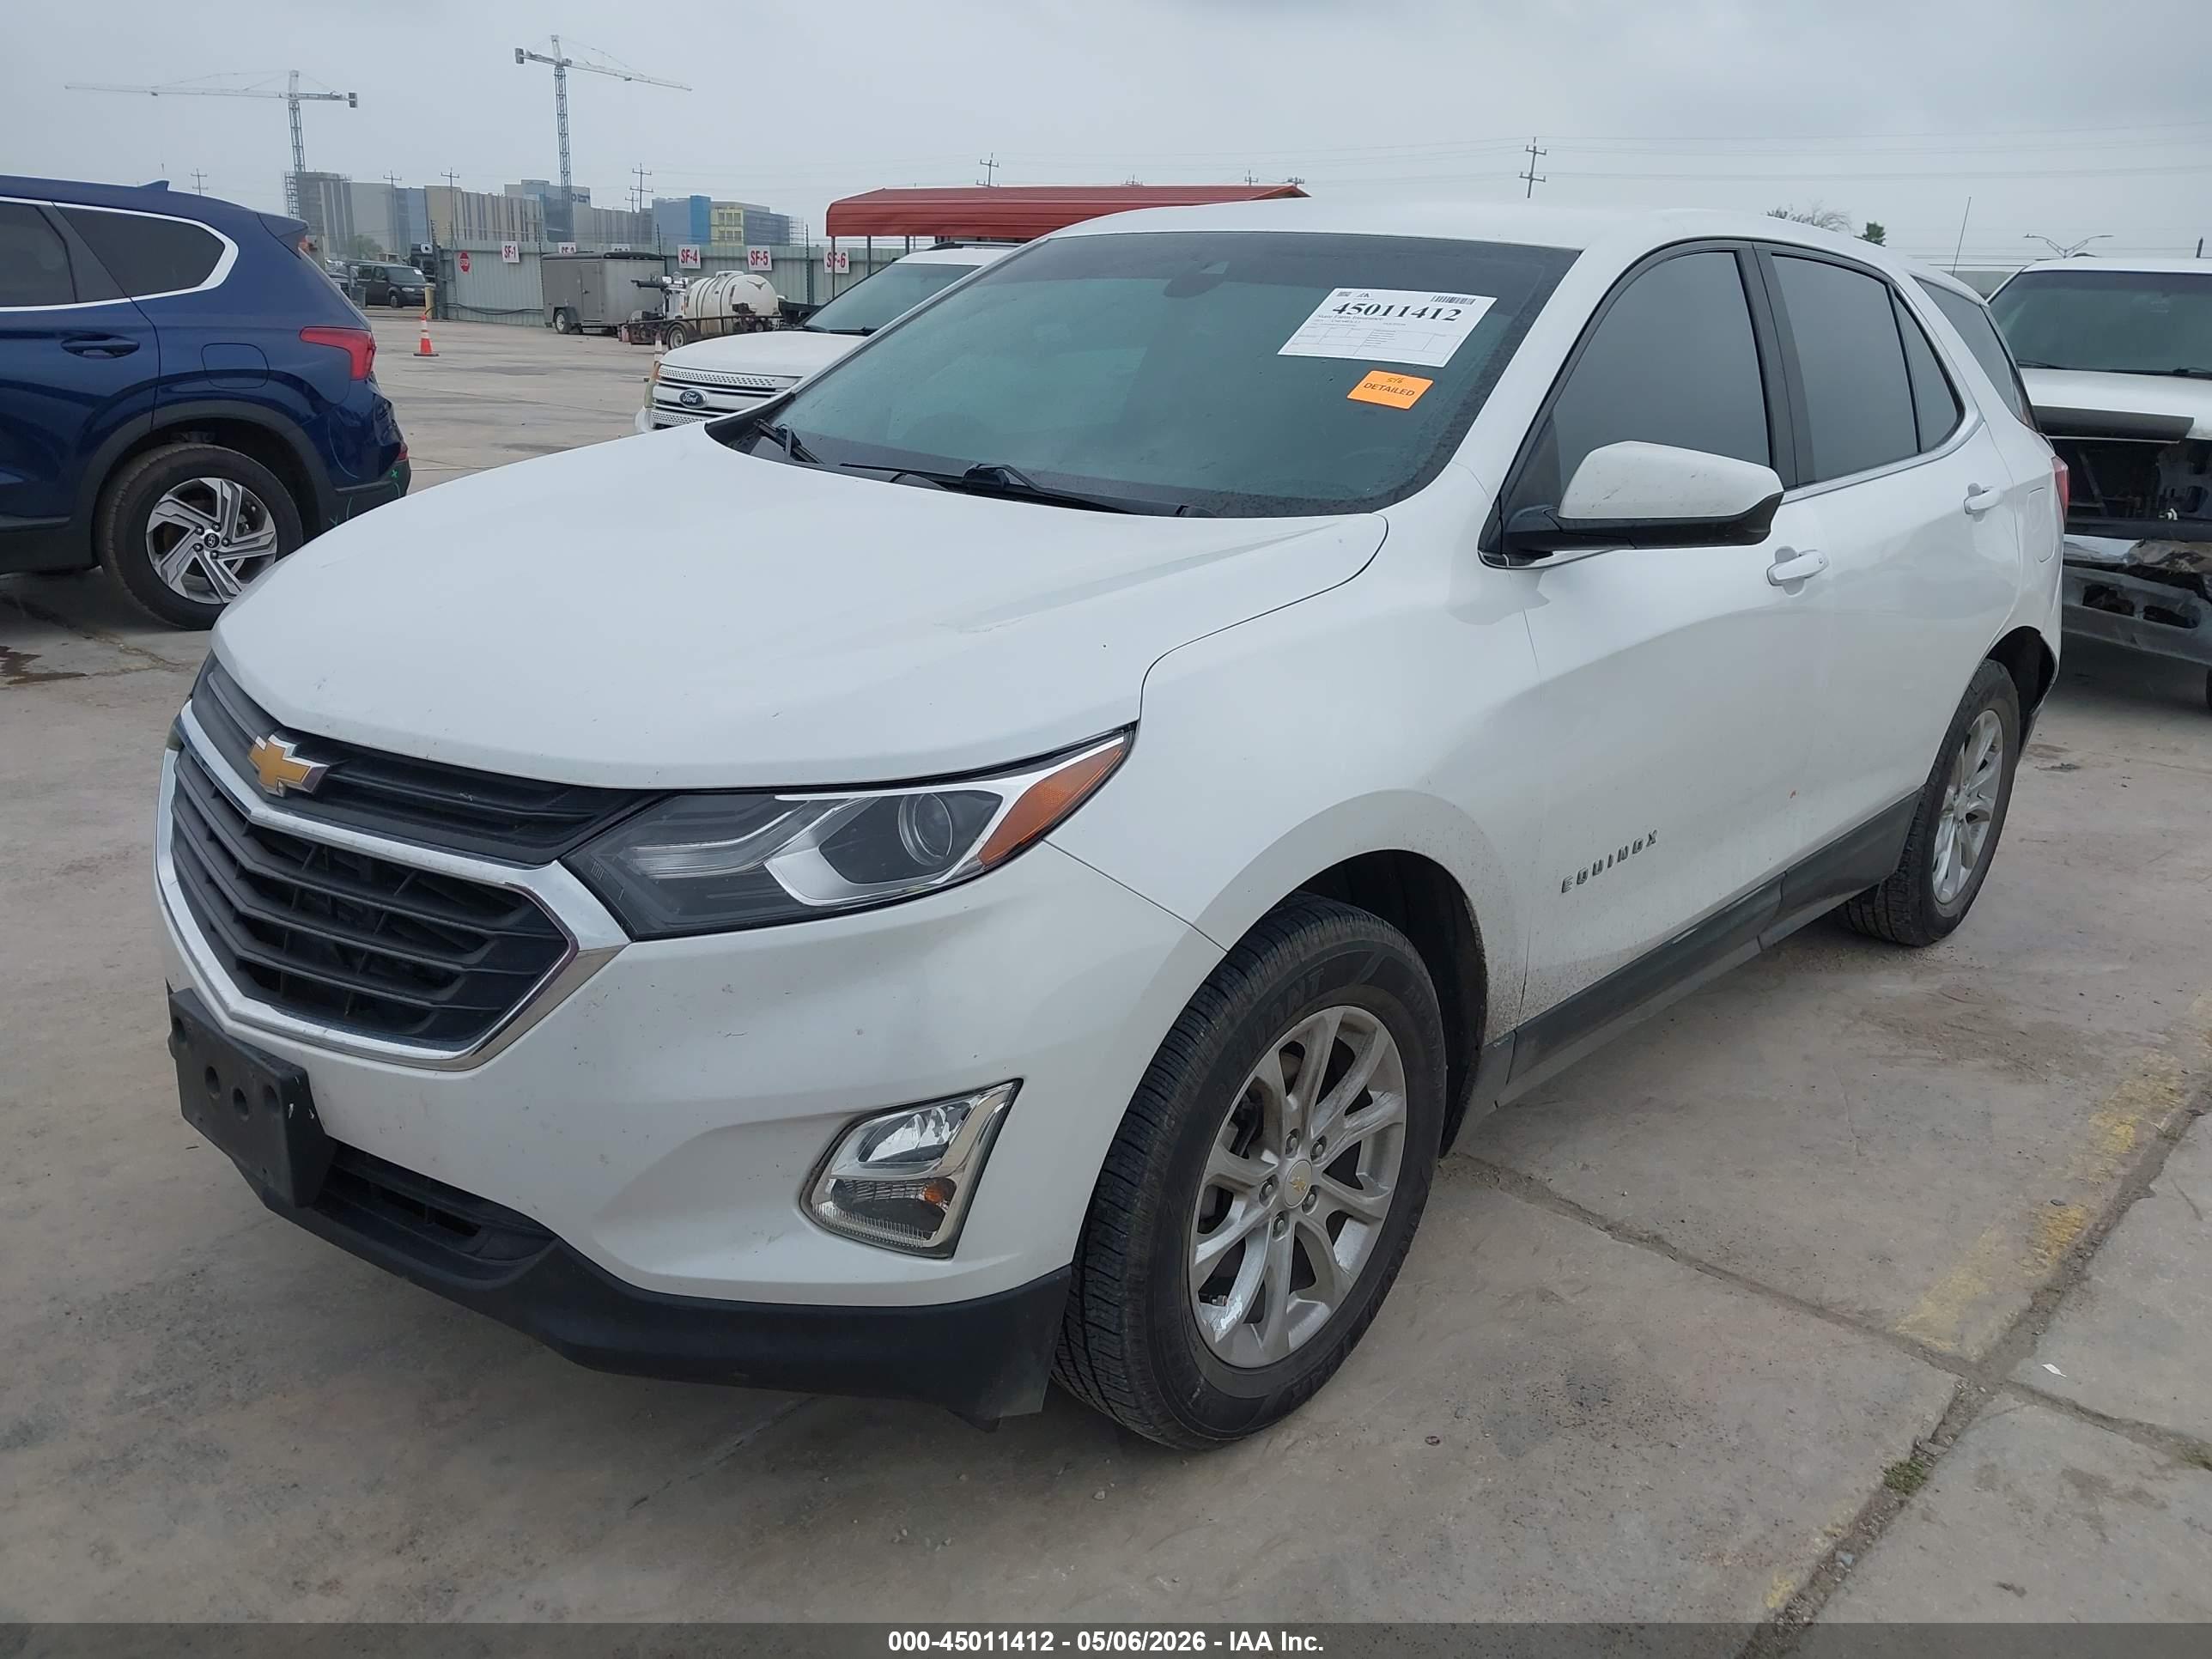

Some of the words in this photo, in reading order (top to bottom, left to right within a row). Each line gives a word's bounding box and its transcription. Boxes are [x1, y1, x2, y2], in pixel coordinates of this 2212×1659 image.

[504, 245, 517, 258] SF-1
[681, 249, 698, 264] SF-4
[750, 250, 769, 266] SF-5
[1332, 301, 1463, 322] 45011412
[1364, 382, 1415, 397] DETAILED
[1561, 830, 1658, 894] EQUINOX
